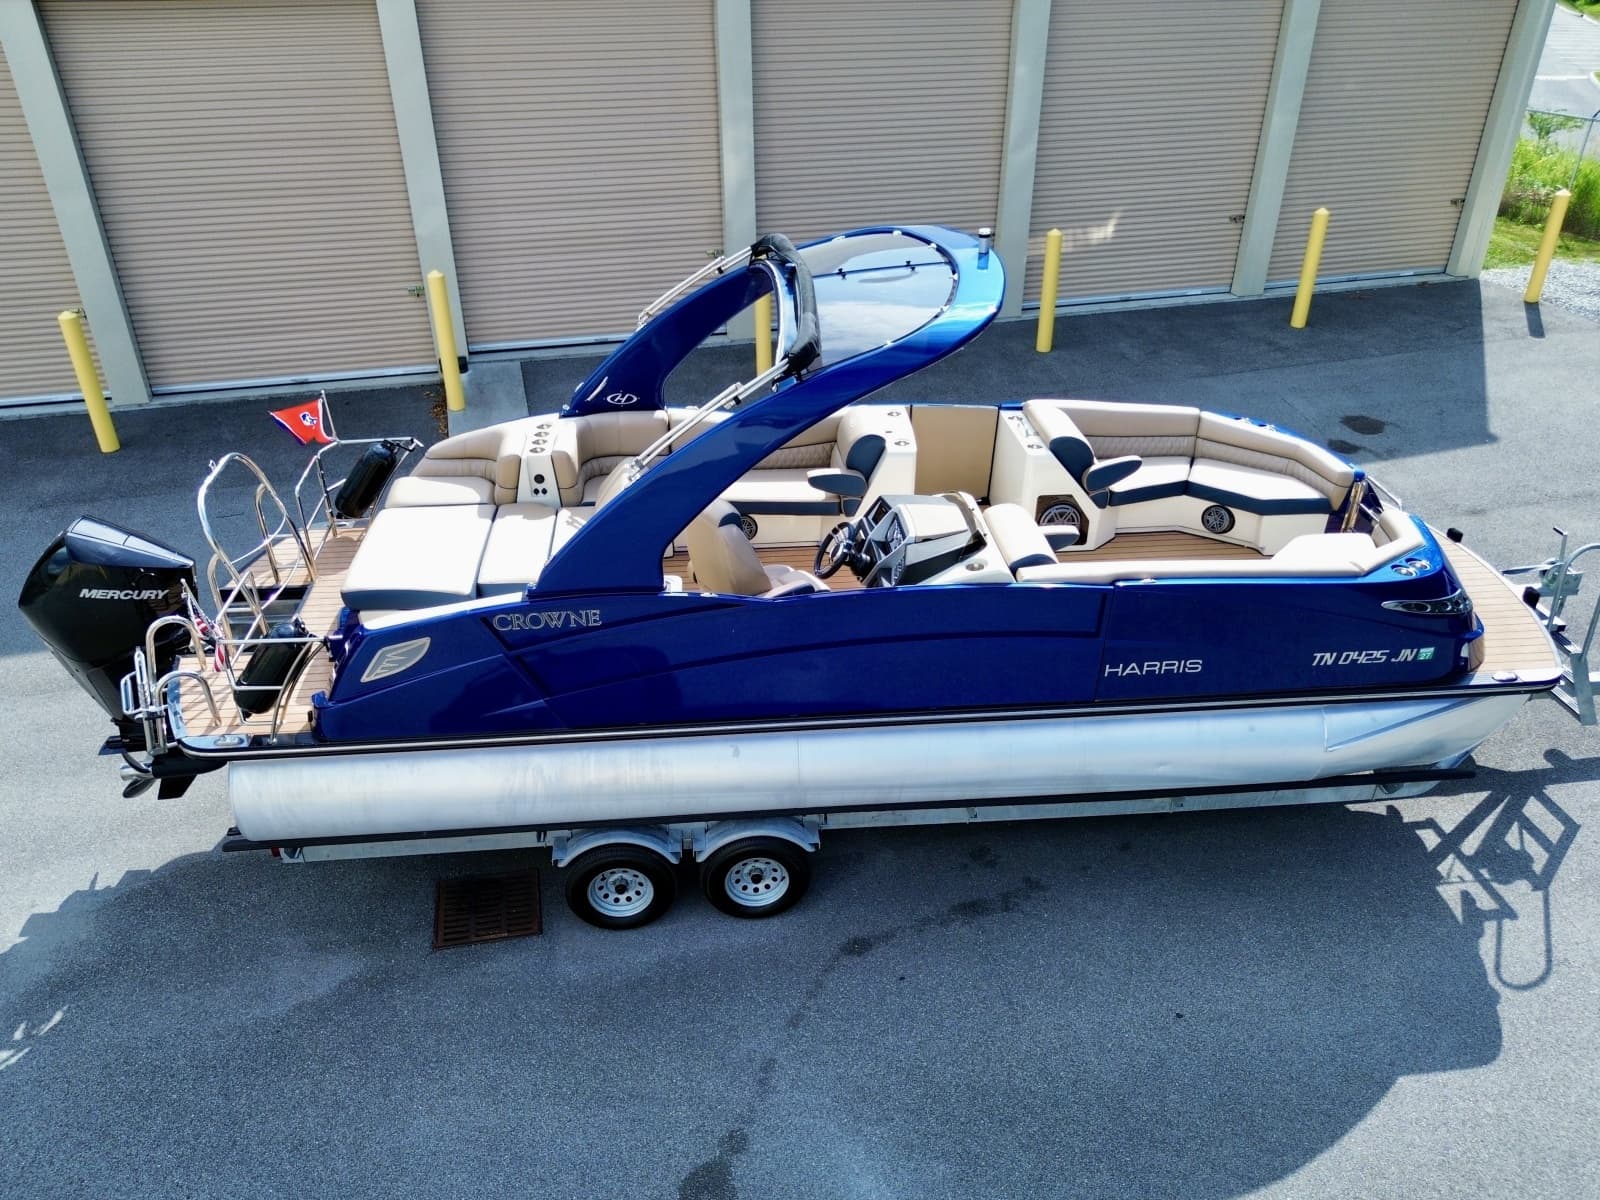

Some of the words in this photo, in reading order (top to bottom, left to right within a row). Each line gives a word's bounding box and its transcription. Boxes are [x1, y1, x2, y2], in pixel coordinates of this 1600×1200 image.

[80, 588, 169, 600] MERCURY
[493, 609, 602, 631] CROWNE
[1312, 652, 1337, 666] TN
[1338, 650, 1390, 665] 0425
[1390, 648, 1418, 662] JN
[1104, 659, 1203, 677] HARRIS
